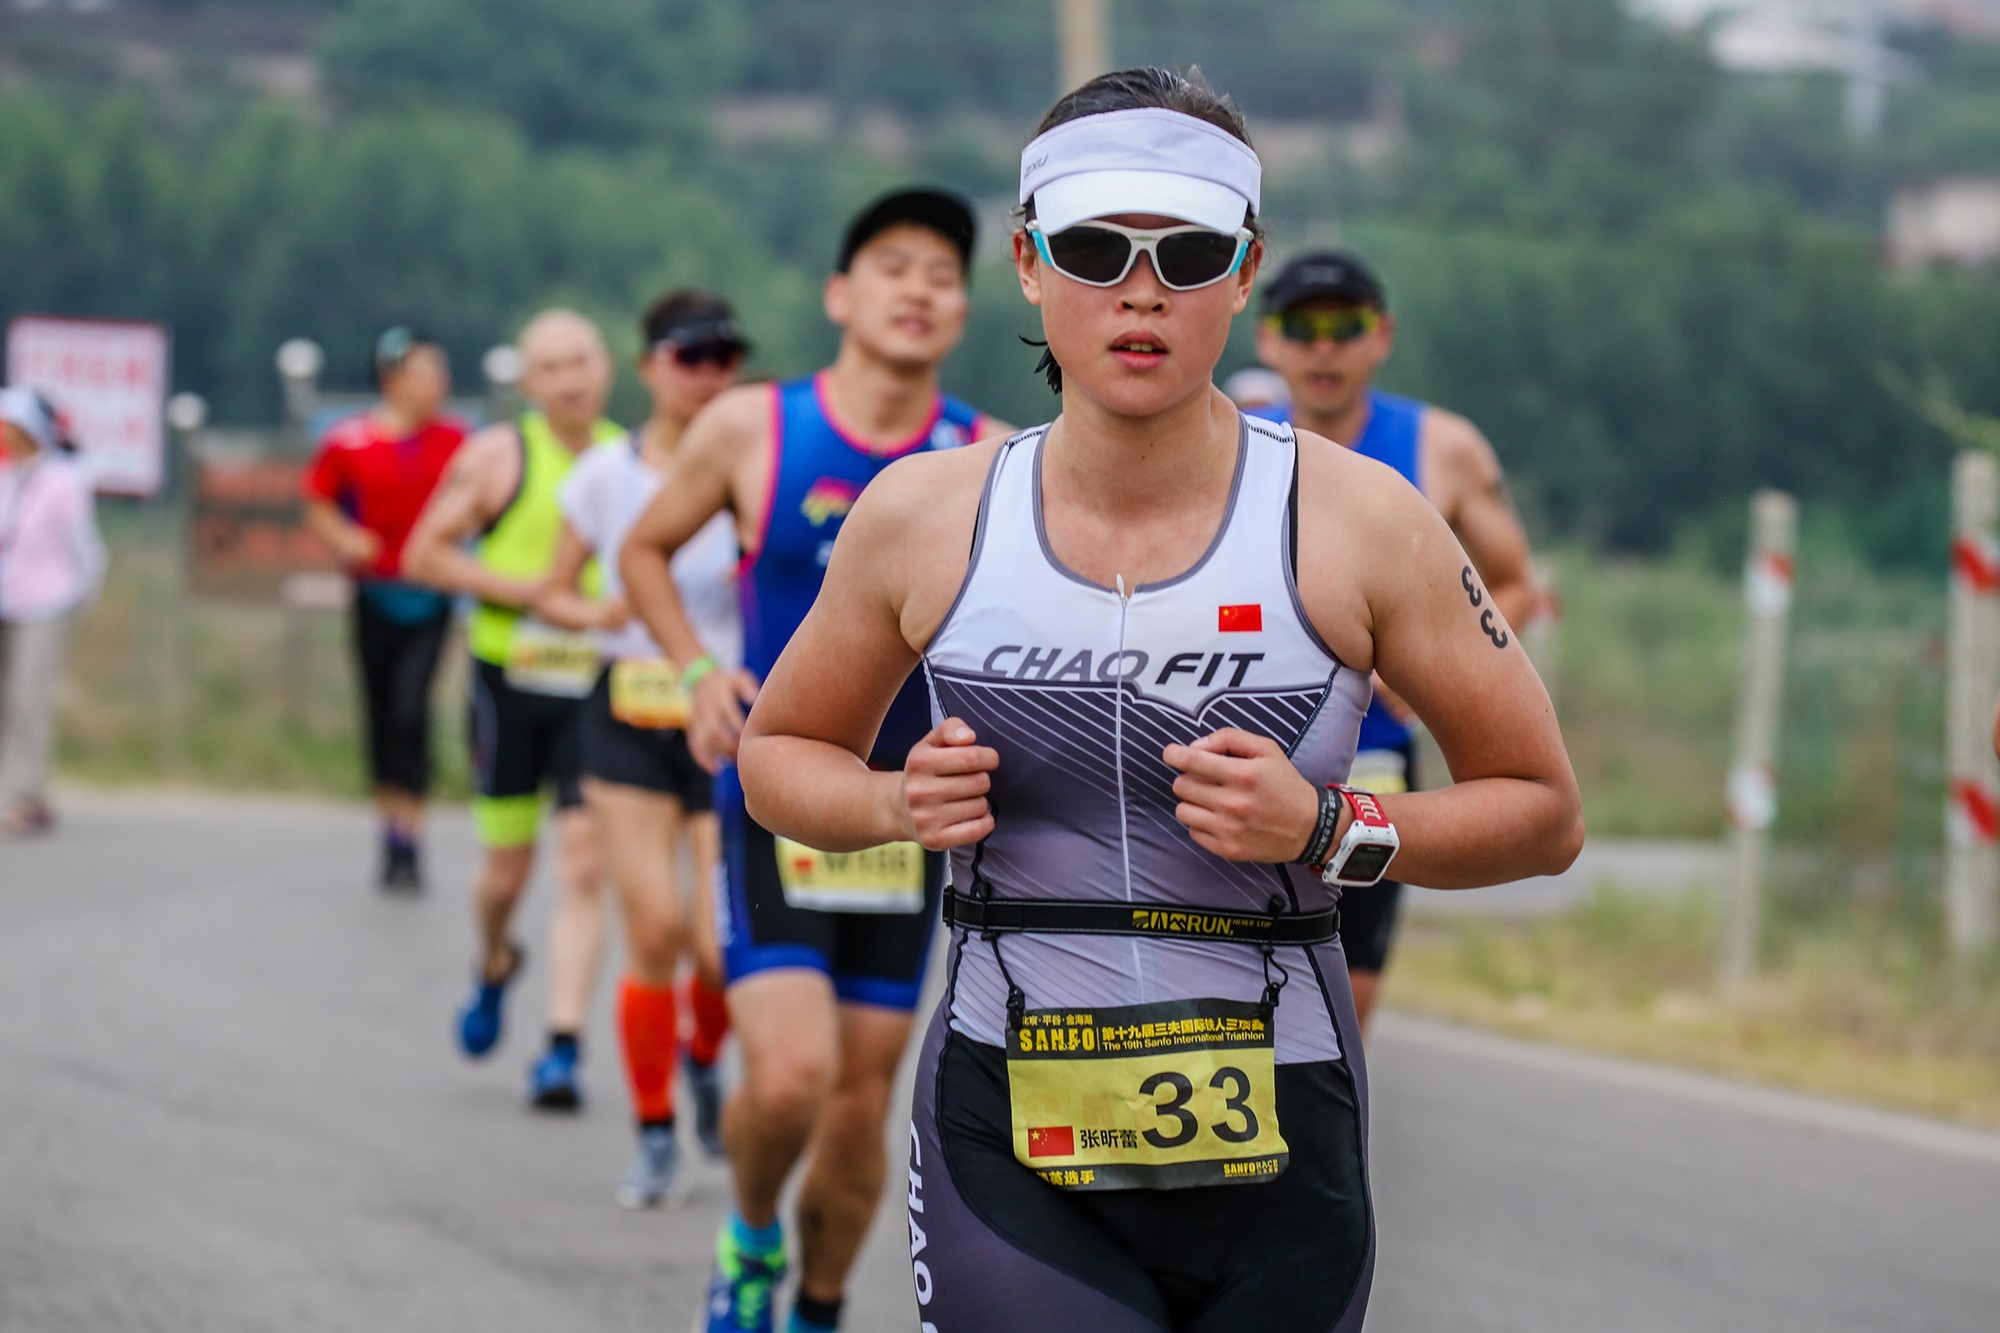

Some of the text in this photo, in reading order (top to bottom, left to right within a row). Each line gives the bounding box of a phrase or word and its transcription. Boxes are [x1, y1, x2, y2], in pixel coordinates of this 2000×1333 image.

[982, 645, 1265, 688] CHAO FIT
[1019, 1028, 1095, 1052] SANFO
[1102, 1031, 1265, 1051] The 19th Sanfo International Triathlon
[1139, 1066, 1259, 1148] 33
[908, 1120, 933, 1306] CHAO
